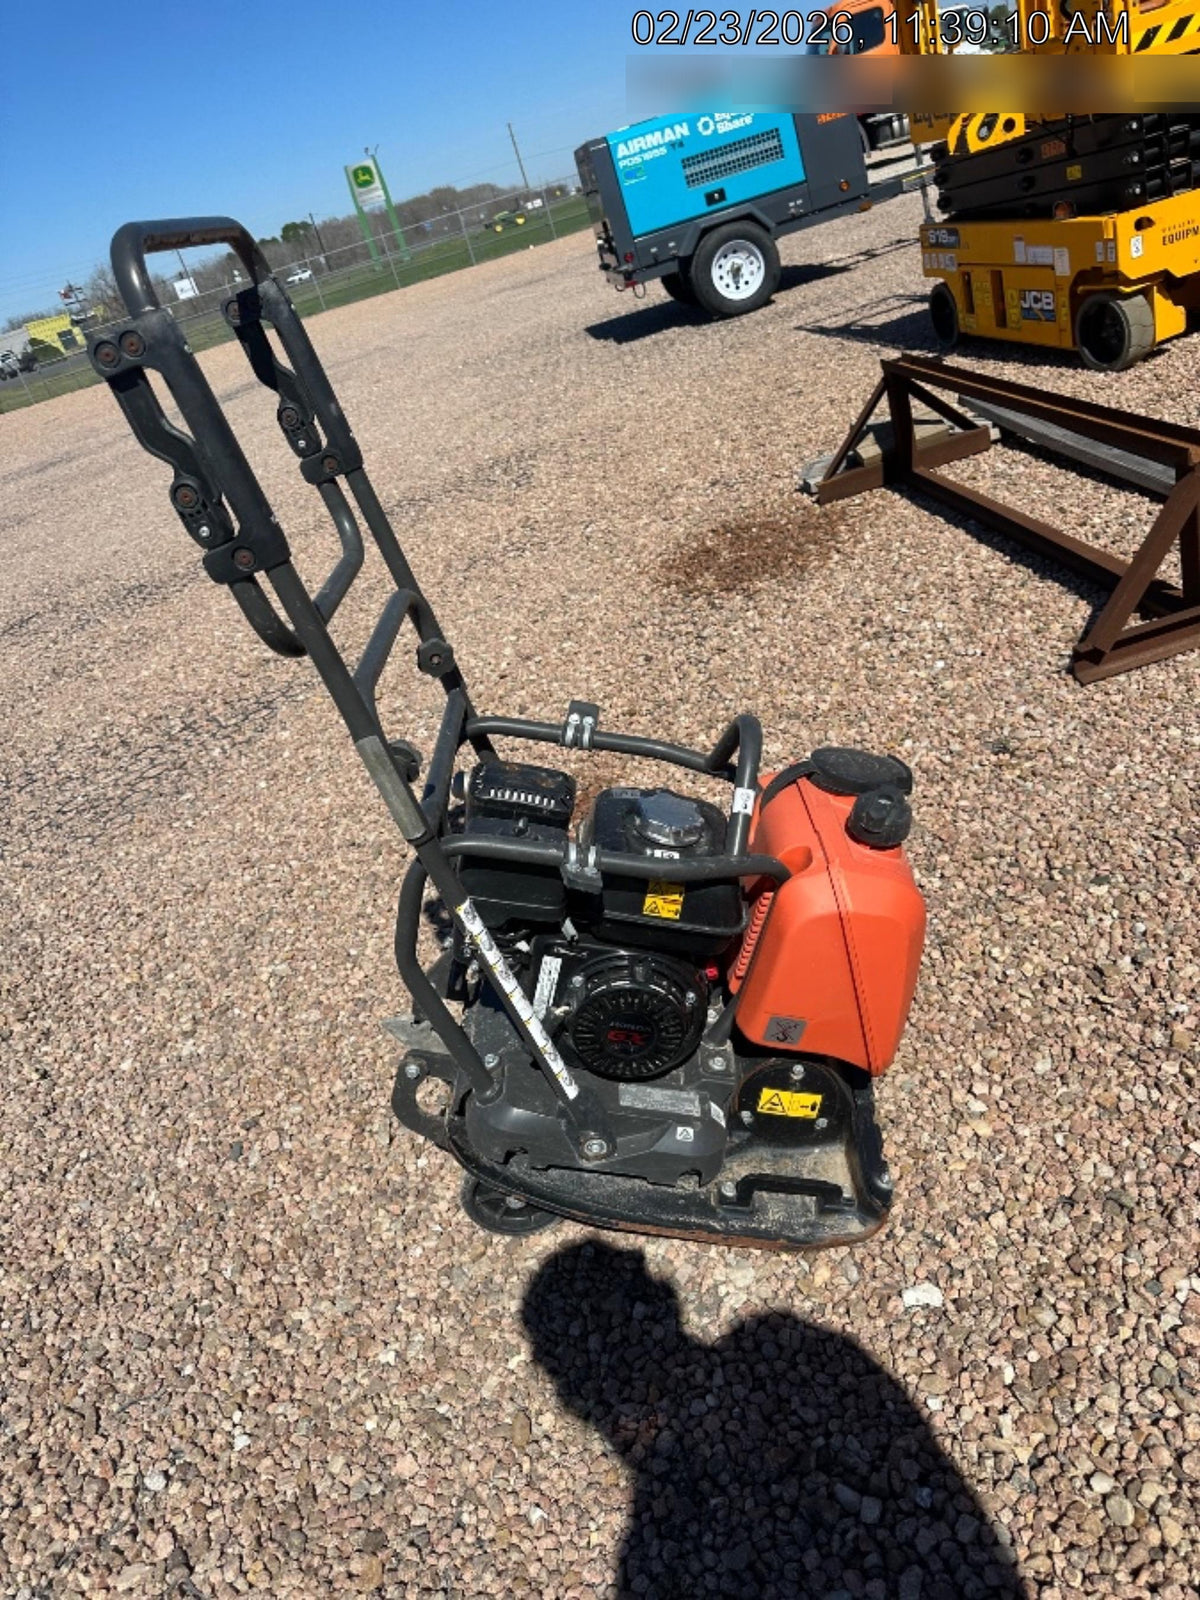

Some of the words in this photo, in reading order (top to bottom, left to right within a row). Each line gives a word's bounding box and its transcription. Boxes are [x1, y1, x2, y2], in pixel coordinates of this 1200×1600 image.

[717, 115, 753, 134] Share
[617, 122, 690, 158] AIRMAN
[1020, 290, 1055, 311] JCB
